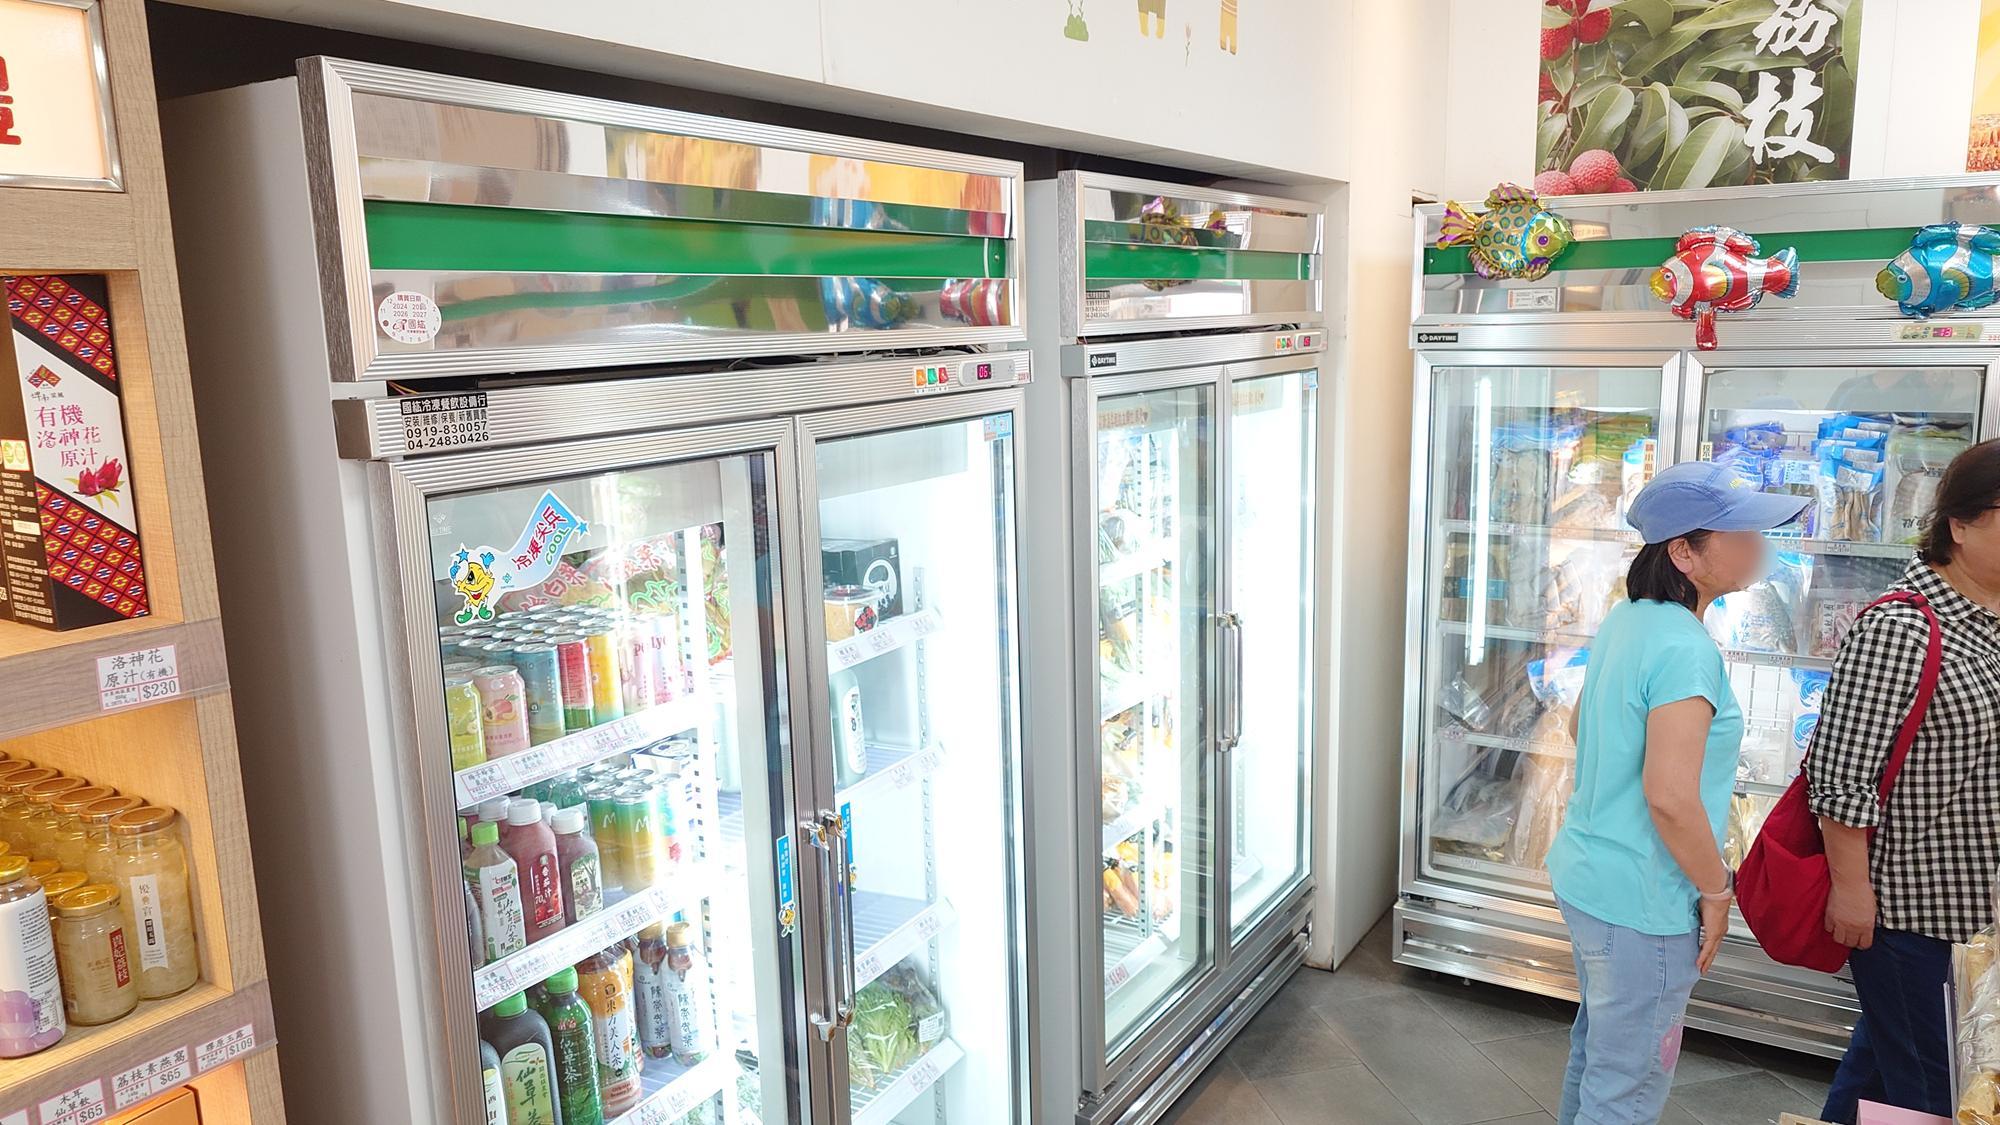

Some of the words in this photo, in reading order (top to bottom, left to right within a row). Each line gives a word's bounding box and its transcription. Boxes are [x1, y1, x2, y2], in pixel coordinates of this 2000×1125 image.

[393, 310, 409, 318] 2026
[34, 404, 84, 428] 有機
[37, 425, 101, 449] 洛神花
[406, 421, 487, 439] 0919-830057
[407, 431, 489, 451] 04-24830426
[60, 447, 98, 468] 原汁
[545, 526, 570, 566] COOL
[111, 648, 164, 670] 洛神花
[142, 679, 177, 699] $230
[605, 999, 623, 1068] 東方美人茶
[229, 1037, 254, 1056] $109
[117, 1049, 185, 1089] 荔枝素燕窩
[159, 1067, 181, 1086] $65
[60, 1088, 83, 1105] 木耳
[79, 1104, 103, 1123] $65
